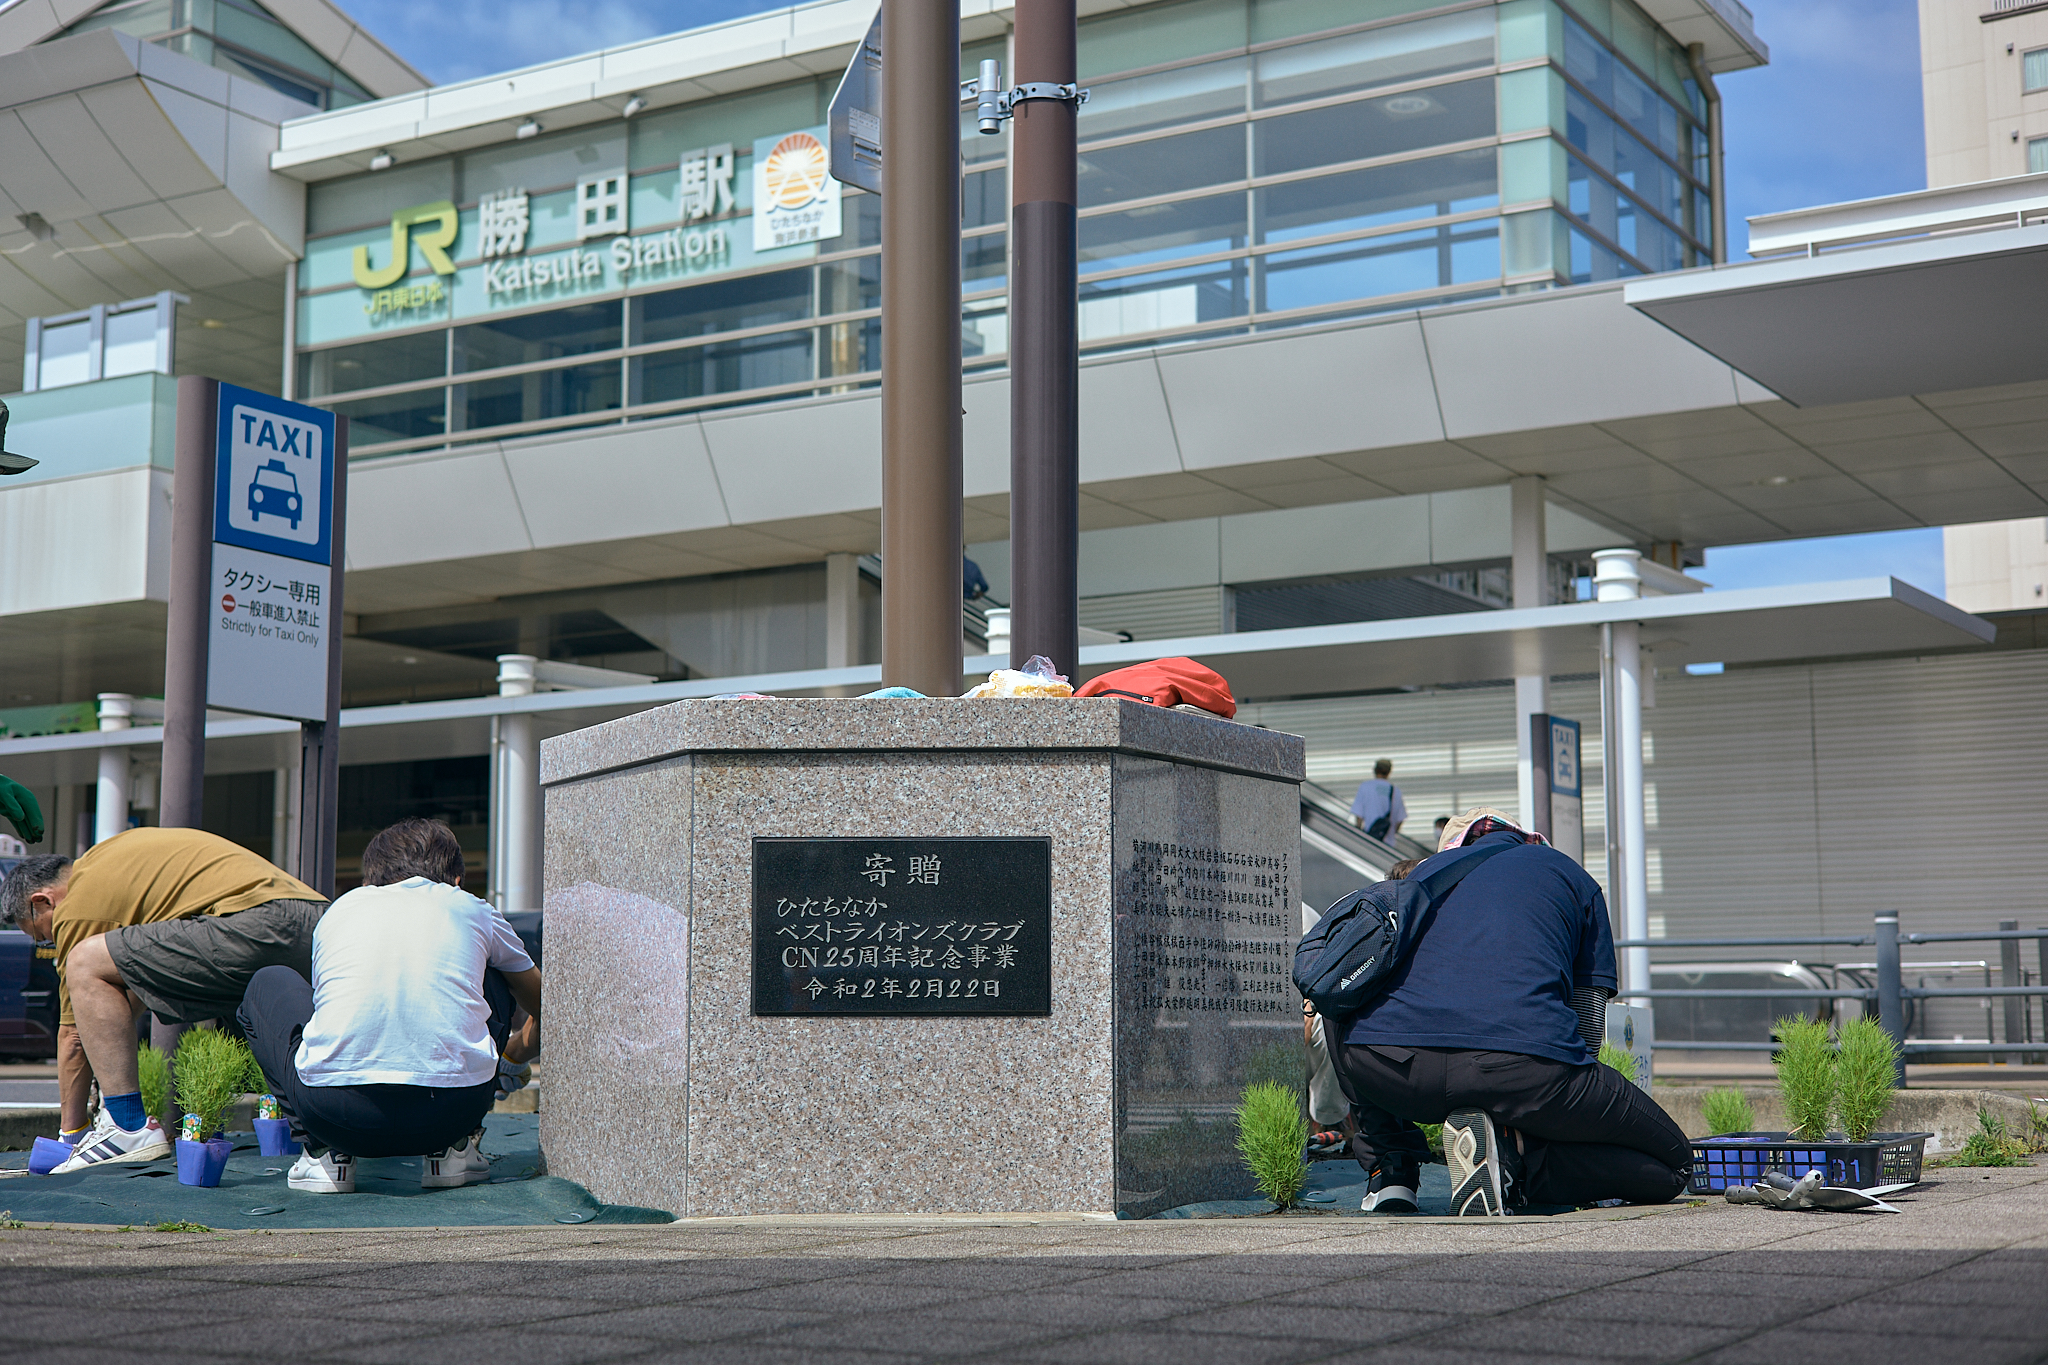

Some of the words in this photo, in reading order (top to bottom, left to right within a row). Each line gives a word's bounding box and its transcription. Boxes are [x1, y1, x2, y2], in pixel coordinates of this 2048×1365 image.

[477, 142, 735, 260] 勝田駅
[353, 200, 459, 289] JR
[482, 248, 600, 294] Katsuta
[610, 224, 727, 273] Station
[364, 281, 444, 315] JR東日本
[240, 413, 313, 460] TAXI
[224, 567, 320, 606] タクシー専用
[237, 599, 320, 628] 一般車進入禁止
[221, 617, 256, 638] Strictly
[258, 623, 273, 638] for
[275, 628, 295, 642] Taxi
[297, 631, 319, 648] Only
[1554, 728, 1574, 747] TAXI
[860, 853, 942, 887] 寄贈
[776, 896, 888, 918] ひたちなか
[775, 919, 1026, 943] ベストライオンズクラブ
[1350, 956, 1377, 981] GREGORY
[802, 976, 1001, 1001] 令和2年2月22日
